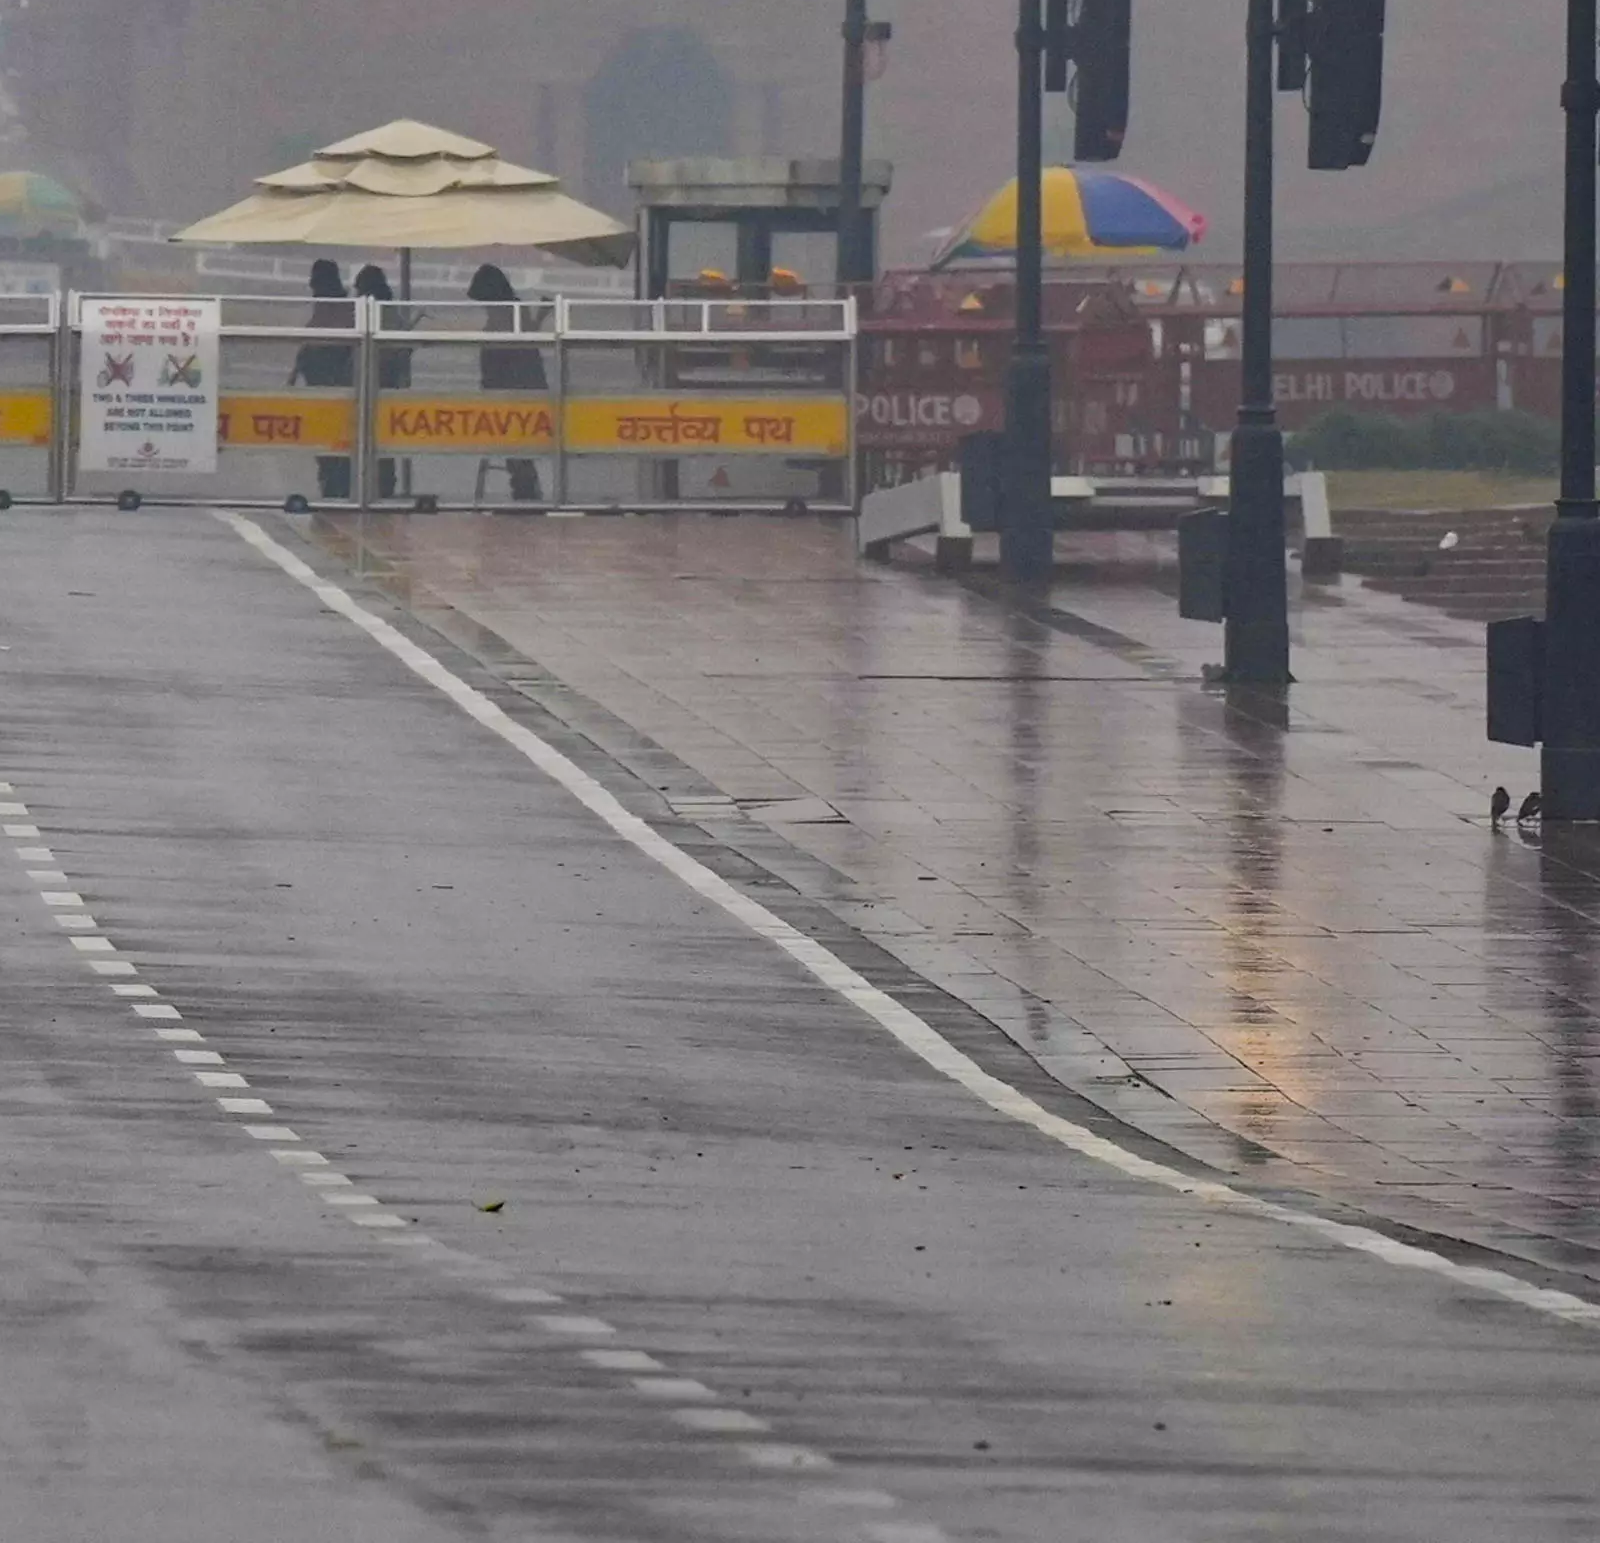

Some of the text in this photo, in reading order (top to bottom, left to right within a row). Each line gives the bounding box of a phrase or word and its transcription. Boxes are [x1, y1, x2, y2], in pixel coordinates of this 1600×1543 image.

[1272, 371, 1429, 401] ELHI POLICE
[389, 409, 555, 437] KARTAVYA
[853, 394, 952, 426] POLICE
[252, 414, 304, 441] पथ
[743, 416, 794, 443] पथ
